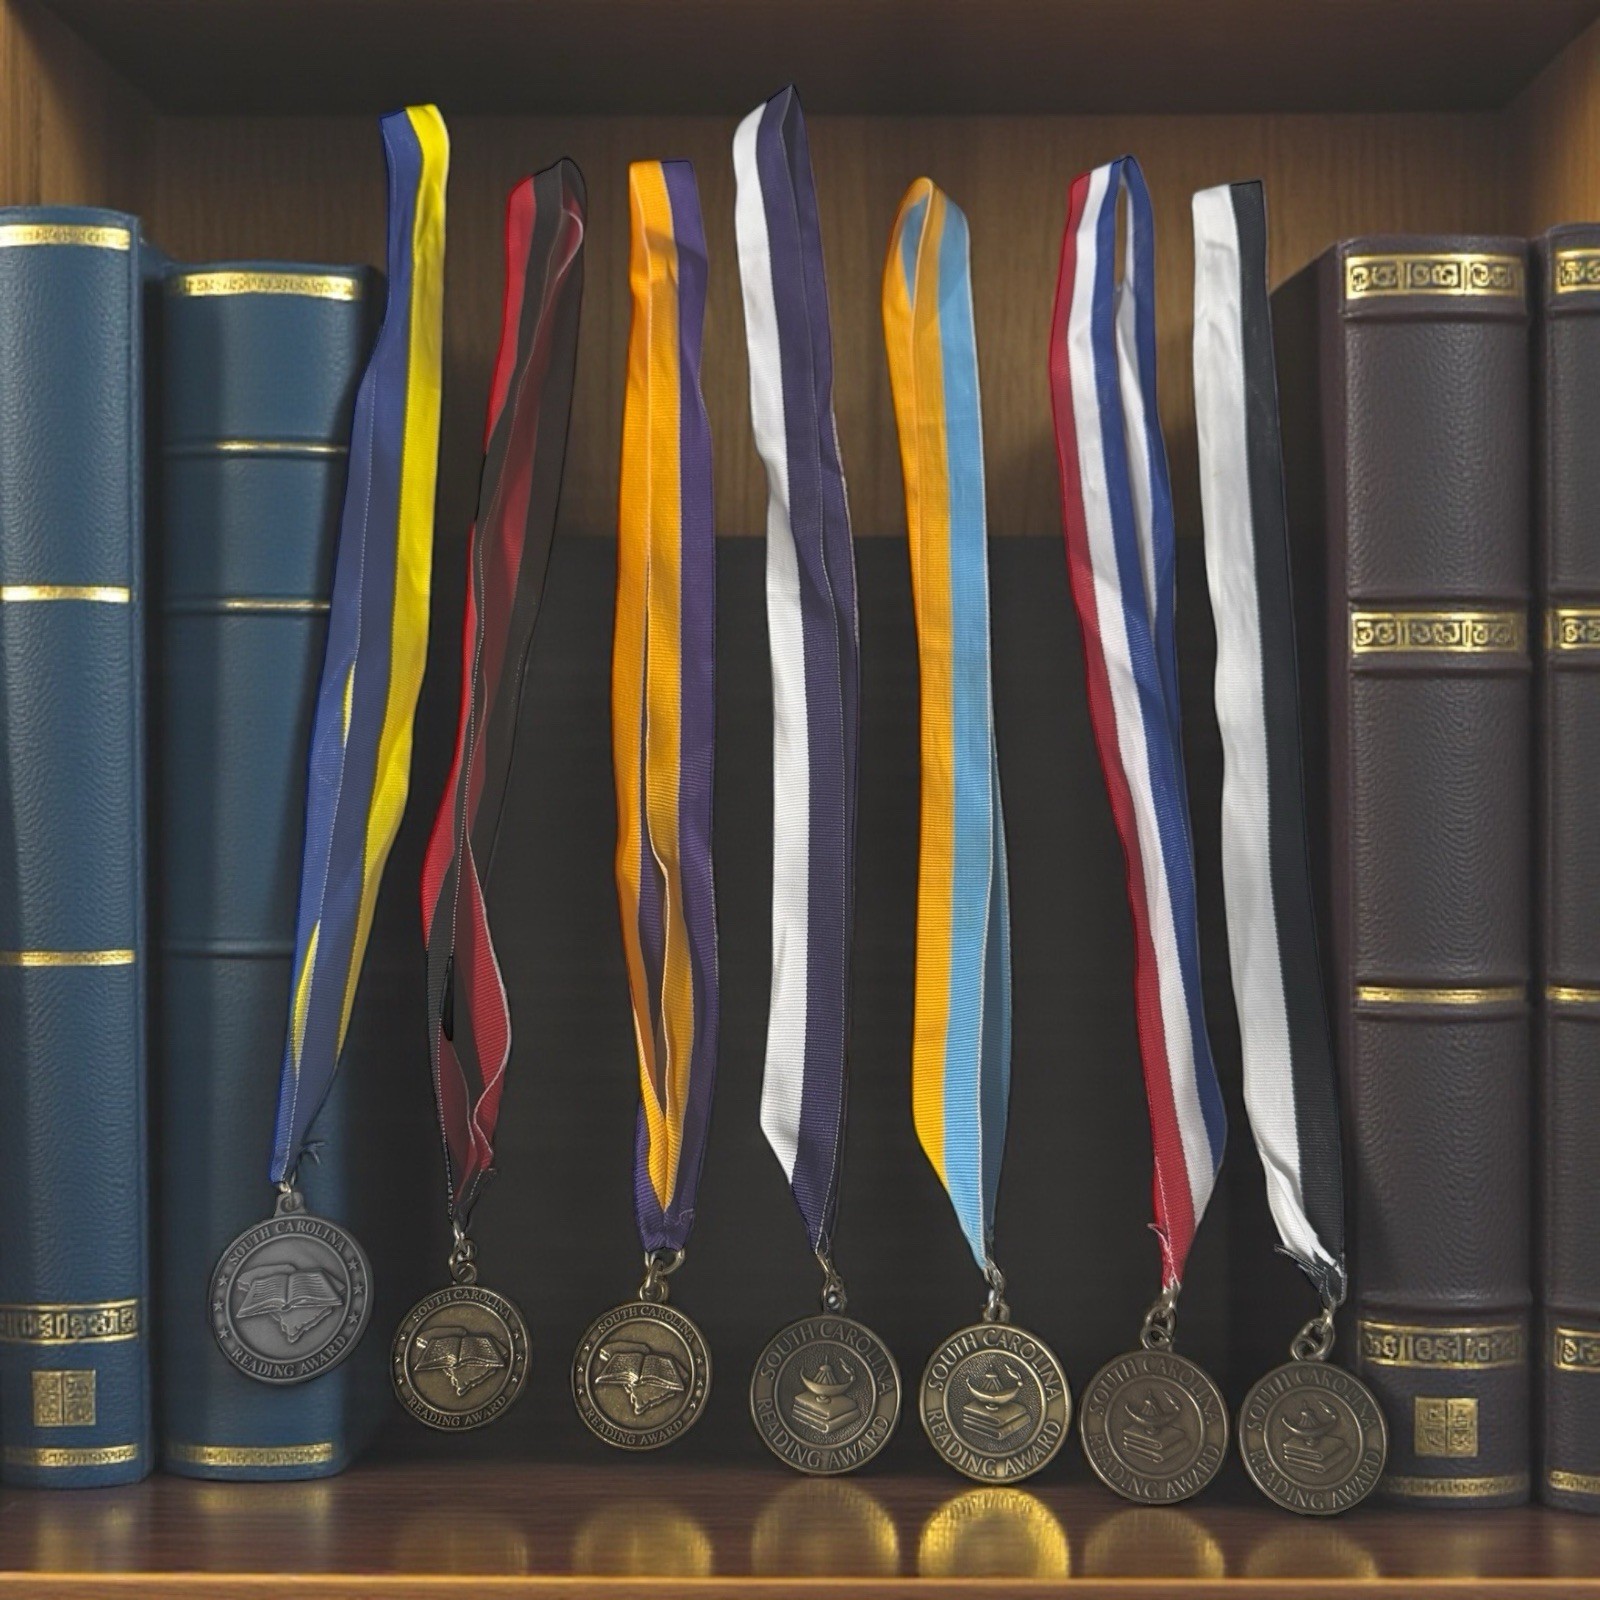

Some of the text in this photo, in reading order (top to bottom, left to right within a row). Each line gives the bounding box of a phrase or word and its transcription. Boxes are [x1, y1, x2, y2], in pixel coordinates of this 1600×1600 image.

[229, 1220, 346, 1266] SOUTH CAROLINA
[412, 1290, 511, 1322] SOUTH CAROLINA
[598, 1306, 695, 1342] SOUTH CAROLINA
[231, 1335, 346, 1377] READING AWARD
[760, 1321, 895, 1396] SOUTH CAROLINA
[928, 1329, 1062, 1401] SOUTH CAROLINA
[408, 1396, 507, 1426] READING AWARD
[1089, 1359, 1137, 1415] SOUTH
[585, 1408, 683, 1444] READING AWARD
[757, 1398, 889, 1468] READING AWARD
[927, 1408, 1061, 1476] READING AWARD
[1089, 1434, 1220, 1498] READING AWARD
